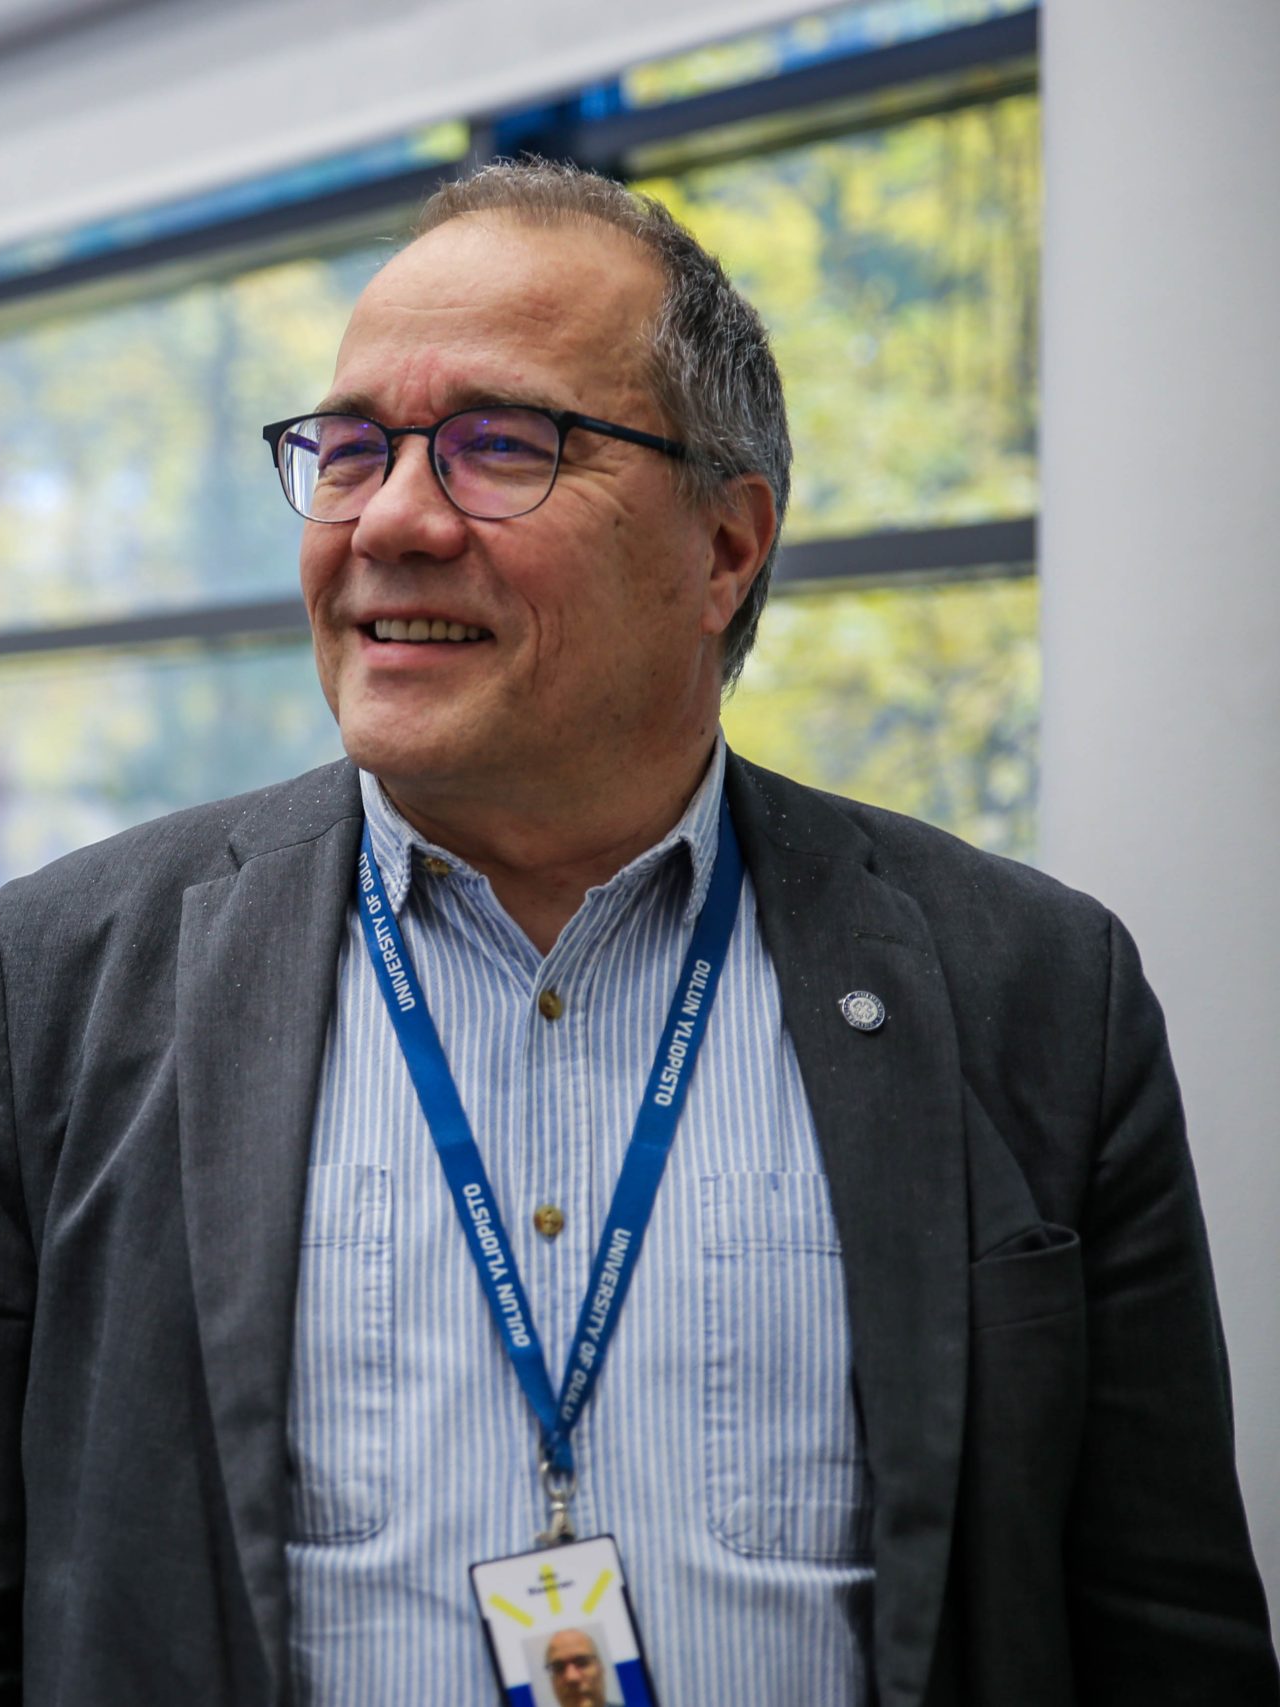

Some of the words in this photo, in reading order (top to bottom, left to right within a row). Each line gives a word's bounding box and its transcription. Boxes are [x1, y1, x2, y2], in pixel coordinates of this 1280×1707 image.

[358, 852, 375, 893] OULU
[366, 894, 382, 915] OF
[372, 915, 416, 1012] UNIVERSITY
[681, 959, 711, 1017] OULUN
[654, 1020, 695, 1107] YLIOPISTO
[462, 1182, 509, 1281] YLIOPISTO
[495, 1282, 531, 1348] OULUN
[585, 1227, 632, 1343] UNIVERSITY
[579, 1341, 596, 1370] OF
[561, 1369, 588, 1423] OULU
